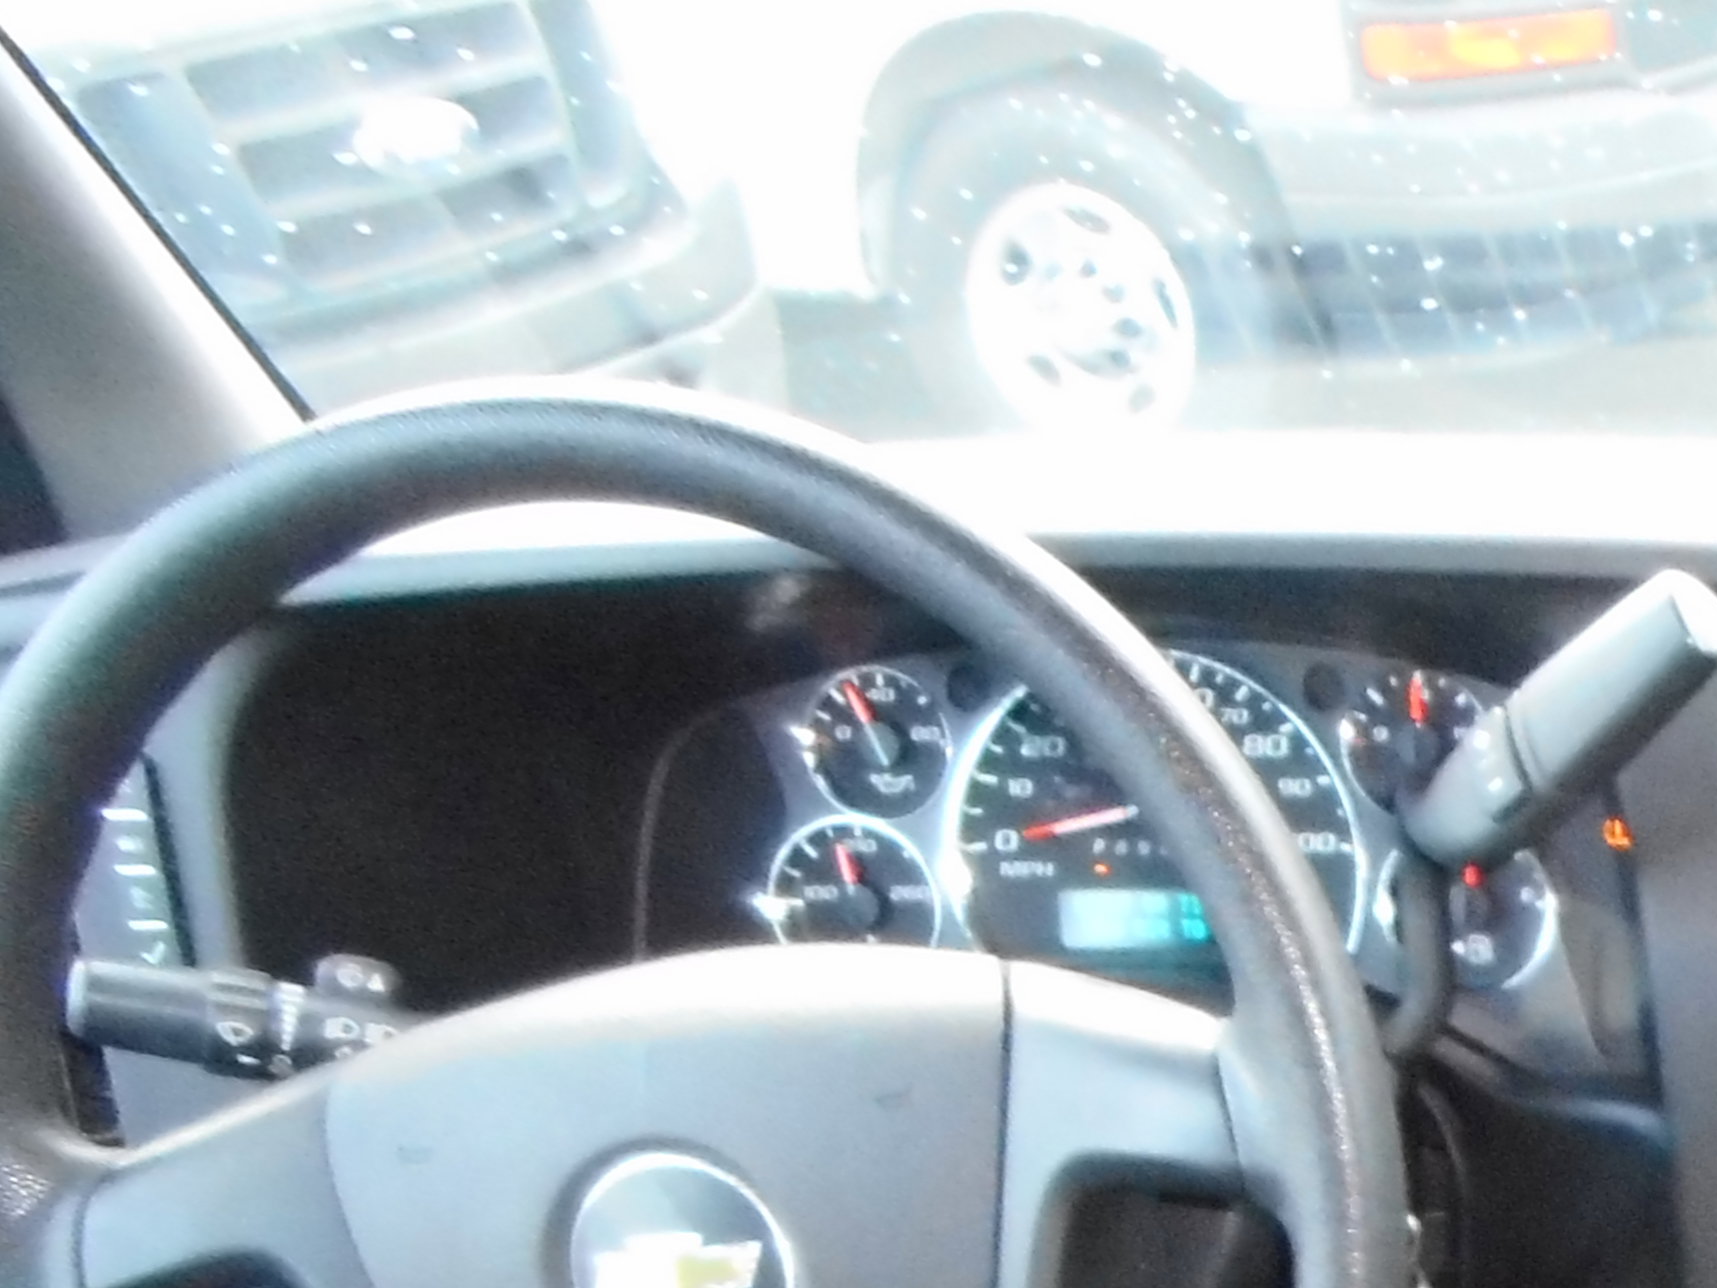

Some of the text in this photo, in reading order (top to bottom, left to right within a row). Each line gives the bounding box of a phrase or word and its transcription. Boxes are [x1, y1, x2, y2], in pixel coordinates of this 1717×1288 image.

[1019, 735, 1067, 758] 20
[1242, 733, 1290, 759] 80
[1007, 777, 1035, 799] 10
[1277, 777, 1313, 798] 90
[993, 828, 1020, 853] 0
[1297, 831, 1338, 854] 00
[999, 860, 1056, 878] MPH
